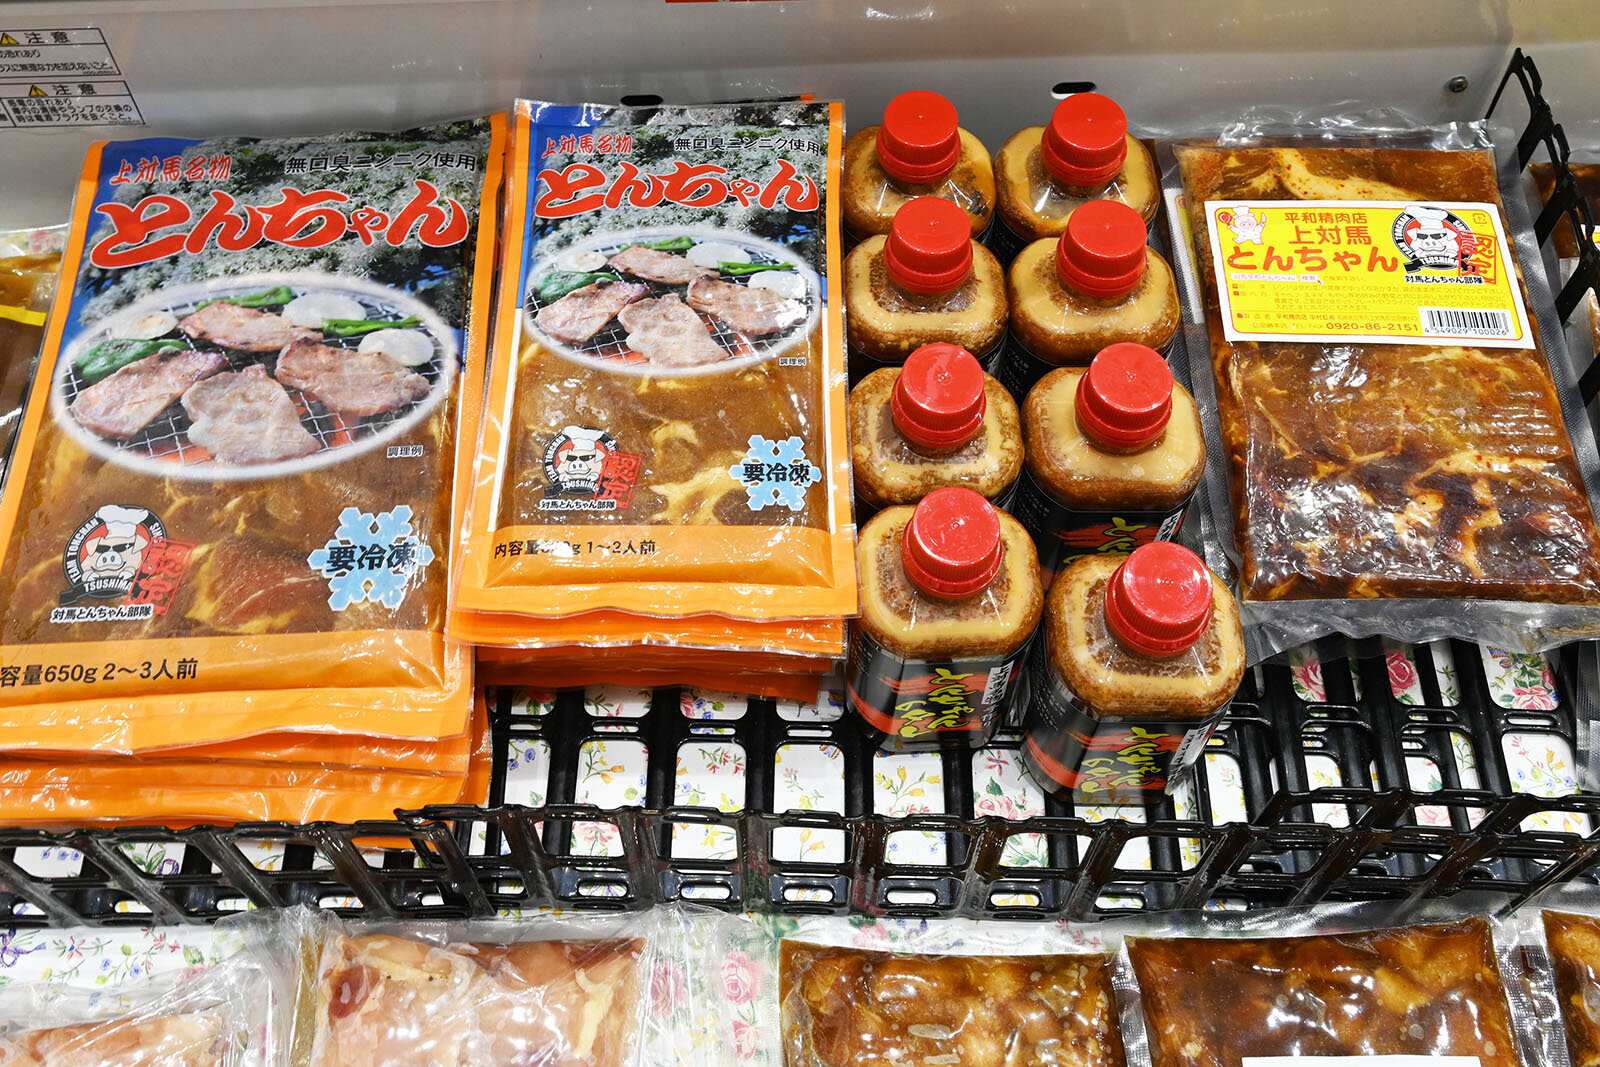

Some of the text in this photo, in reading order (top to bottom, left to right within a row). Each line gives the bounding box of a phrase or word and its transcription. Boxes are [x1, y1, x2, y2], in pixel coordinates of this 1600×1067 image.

[24, 32, 69, 43] 注意
[52, 84, 96, 95] 注意
[541, 133, 632, 159] 上対馬名物
[675, 137, 821, 156] 無口臭ニンニク使用
[110, 154, 231, 185] 上対馬名物
[286, 152, 477, 174] 無口臭ニンニク使用
[535, 160, 819, 218] とんちゃん
[91, 180, 469, 269] とんちゃん
[1285, 212, 1368, 224] 平和精肉店
[1289, 225, 1372, 245] 上対馬
[1228, 246, 1398, 272] とんちゃん
[1405, 275, 1483, 285] 対馬とんちゃん部隊
[1326, 322, 1418, 331] 0920-86-2151
[743, 463, 811, 482] 要冷凍
[541, 501, 615, 510] 対馬とんちゃん部隊
[66, 517, 99, 557] TONCHAN
[326, 542, 416, 572] 要冷凍
[66, 561, 82, 584] TEAM
[53, 605, 151, 621] 対馬とんちゃん部隊
[0, 664, 98, 688] 容量650g
